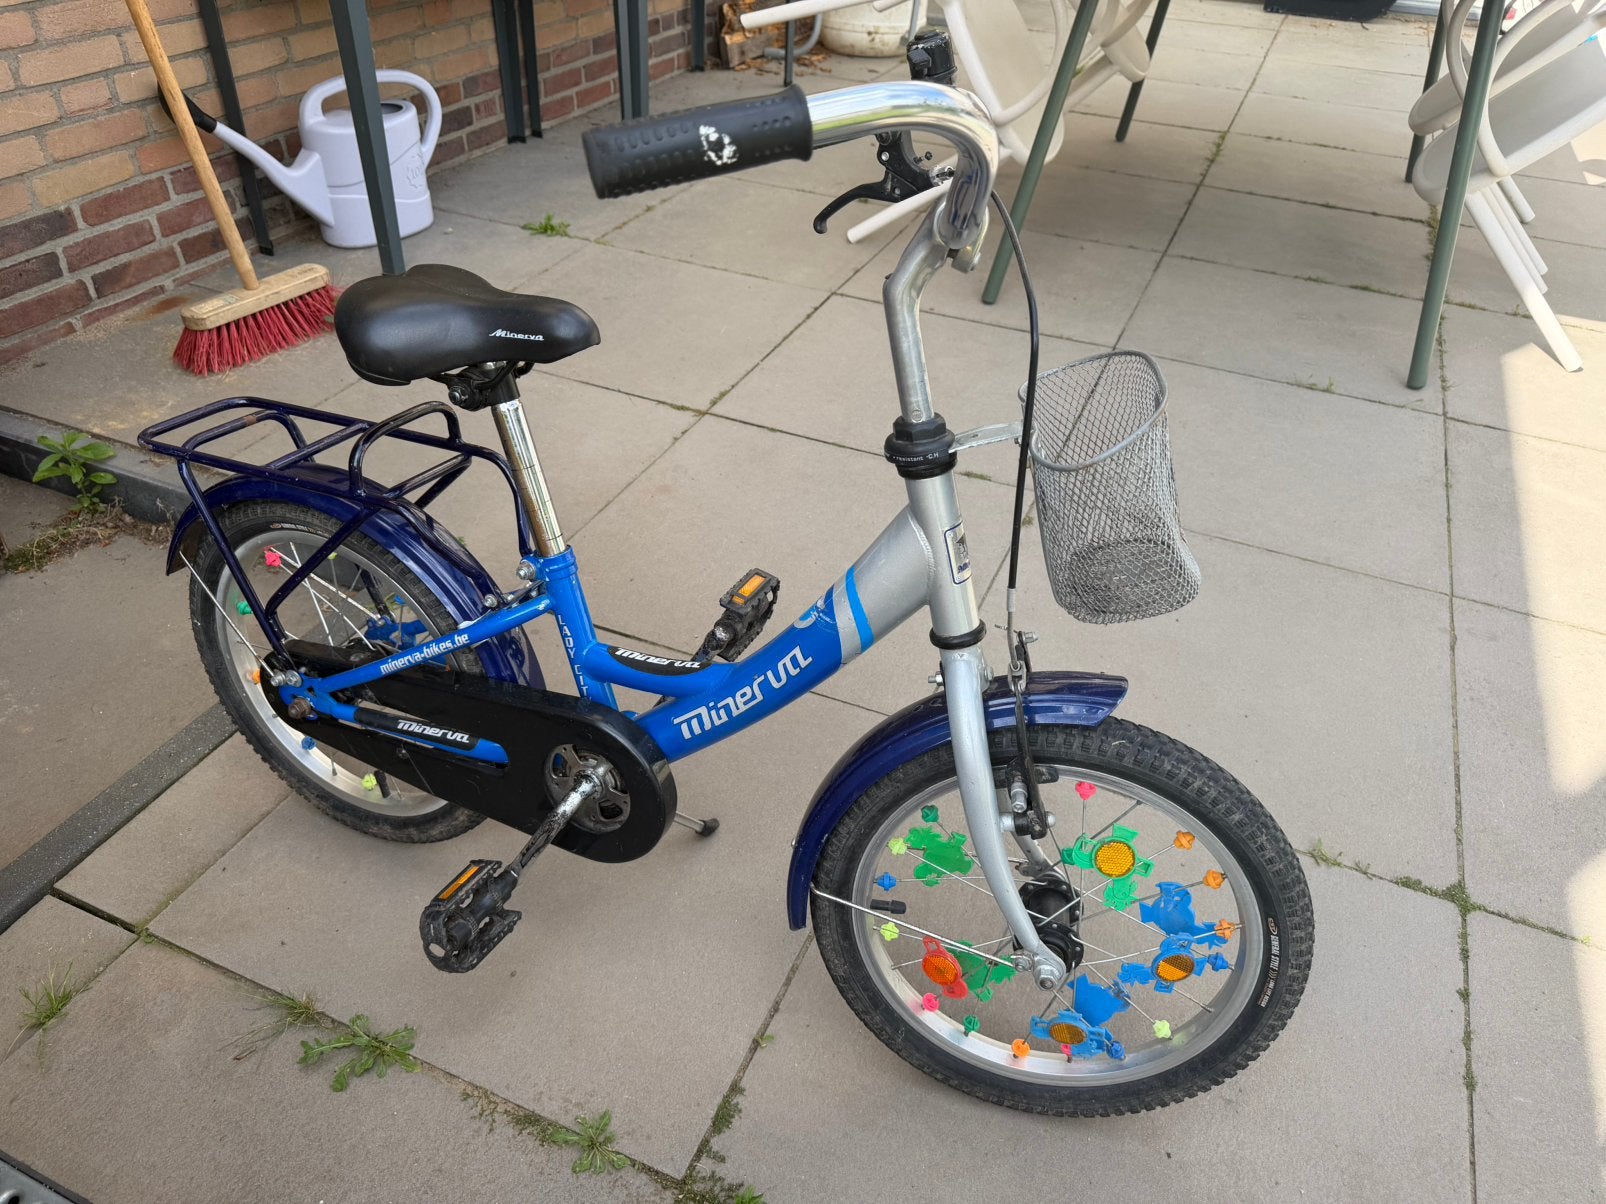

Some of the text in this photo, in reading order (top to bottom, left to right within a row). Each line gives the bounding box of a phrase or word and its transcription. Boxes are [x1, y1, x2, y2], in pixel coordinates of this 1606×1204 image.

[489, 329, 544, 340] Minerva
[380, 633, 470, 674] minerva-bikes.be
[558, 615, 592, 700] LADY CIT
